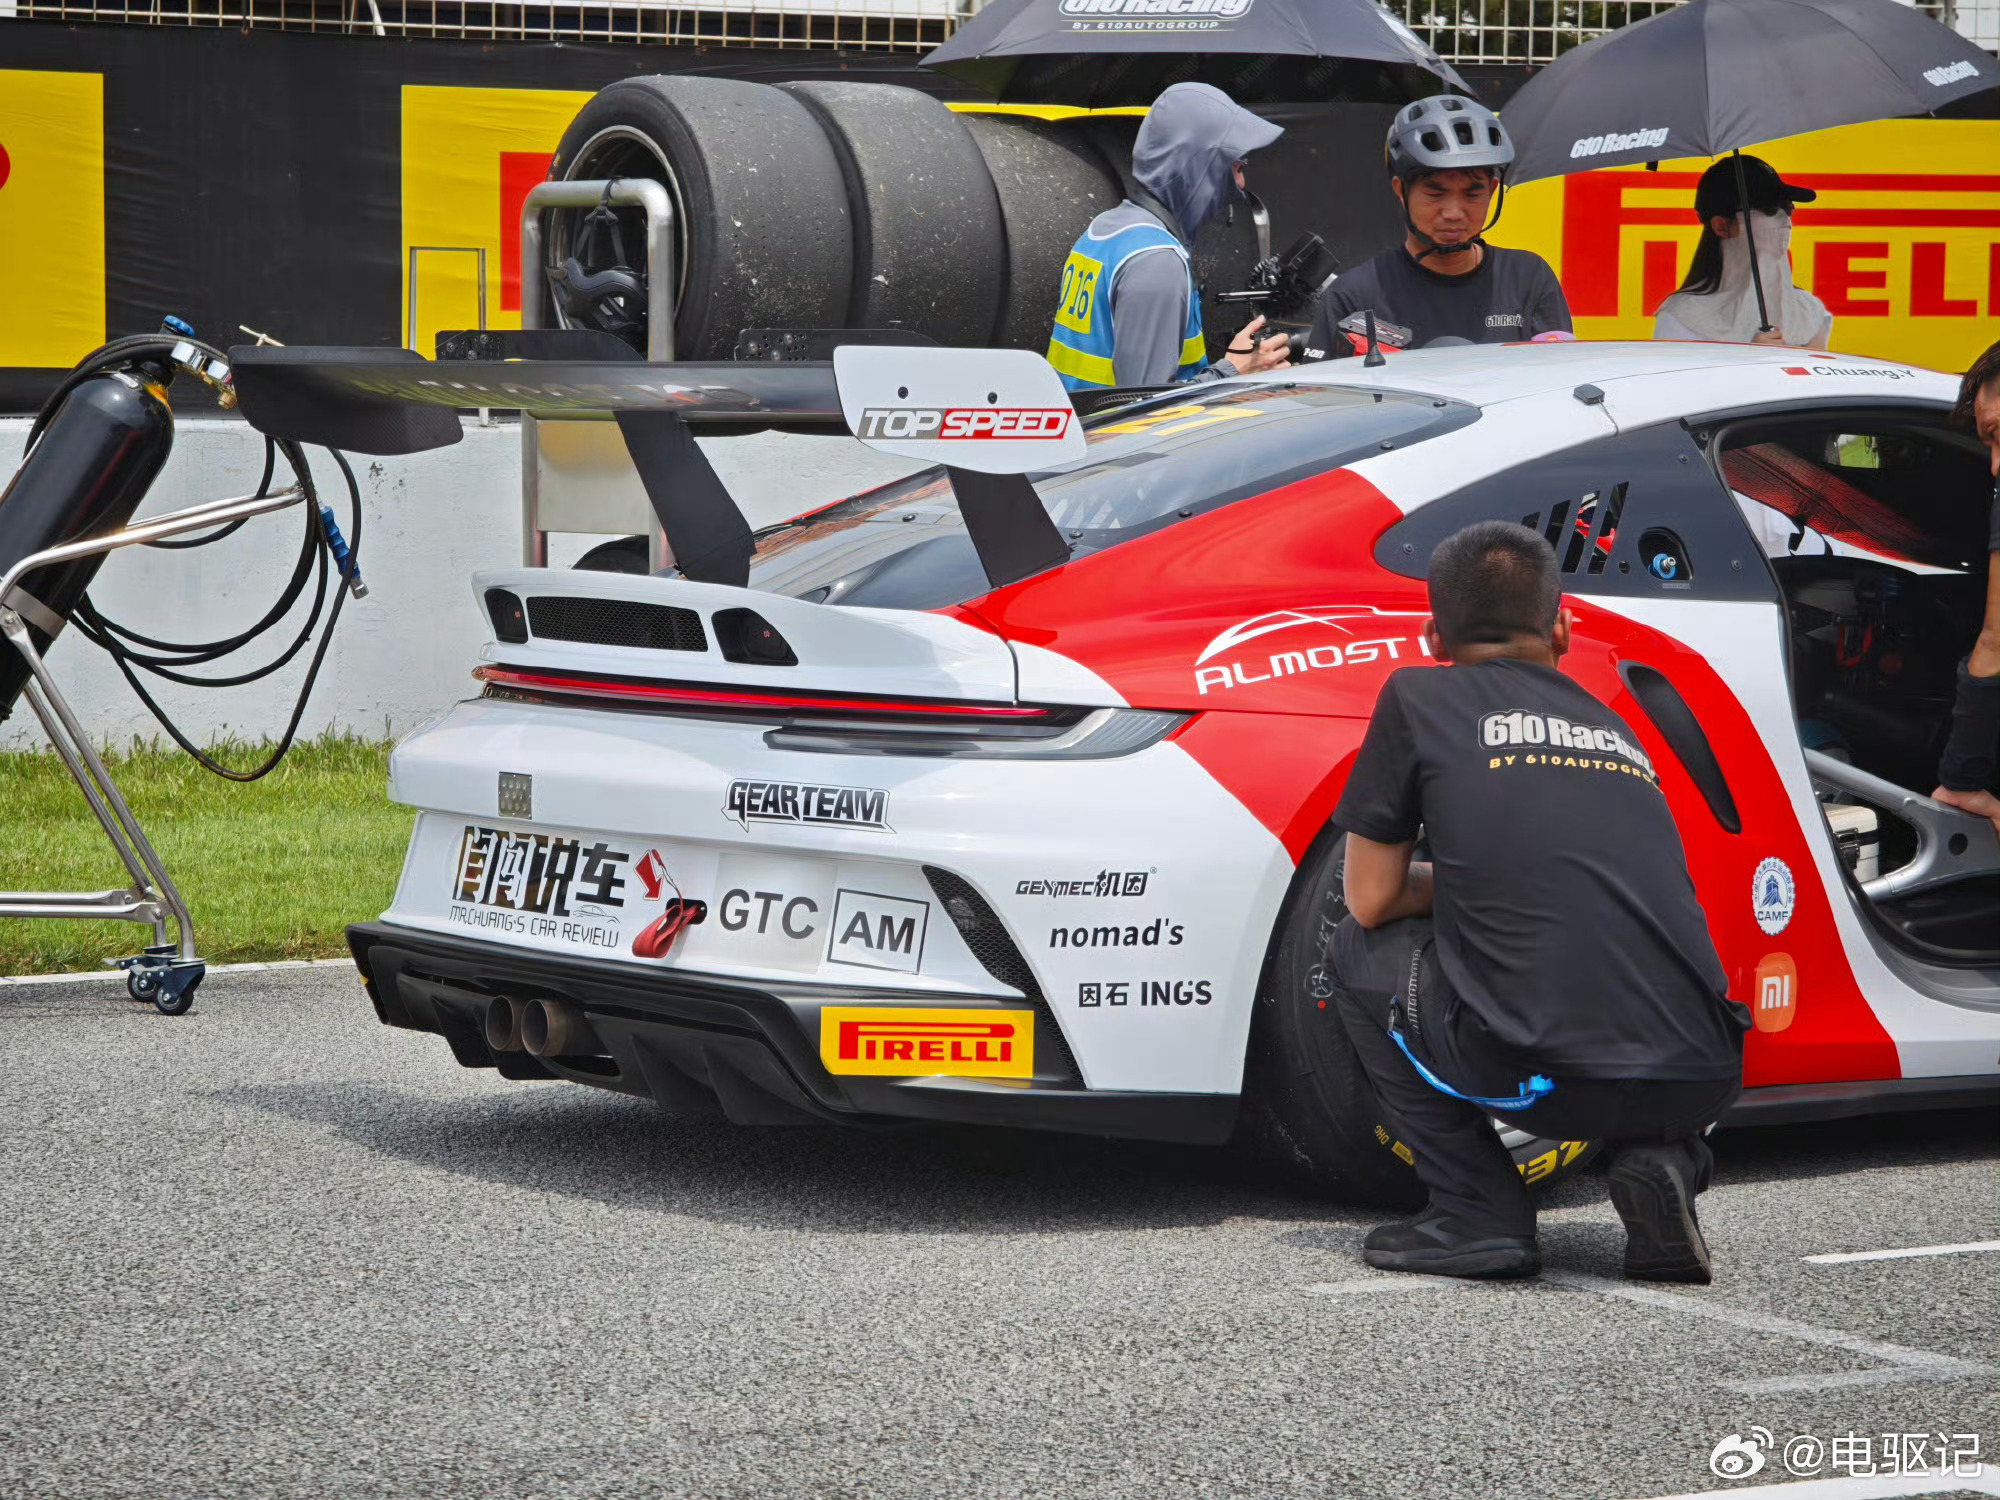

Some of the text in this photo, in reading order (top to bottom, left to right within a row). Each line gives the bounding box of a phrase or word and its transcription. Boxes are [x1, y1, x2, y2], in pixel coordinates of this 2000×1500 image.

[1072, 22, 1219, 31] By 610AUTOGROUP
[1562, 171, 2000, 317] PIEL
[863, 409, 1069, 438] TOP SPEED
[1195, 637, 1407, 695] ALMOST
[1490, 754, 1656, 786] BY 610AUTOGRO
[719, 887, 819, 940] GTC
[1757, 910, 1789, 922] CAMF
[530, 916, 557, 938] CAR
[561, 923, 620, 949] REVIEW
[838, 911, 916, 955] AM
[1050, 917, 1185, 948] nomad's
[1078, 982, 1130, 1008] 因石
[838, 1020, 1016, 1063] PIRELLI
[1516, 1140, 1588, 1185] ZE
